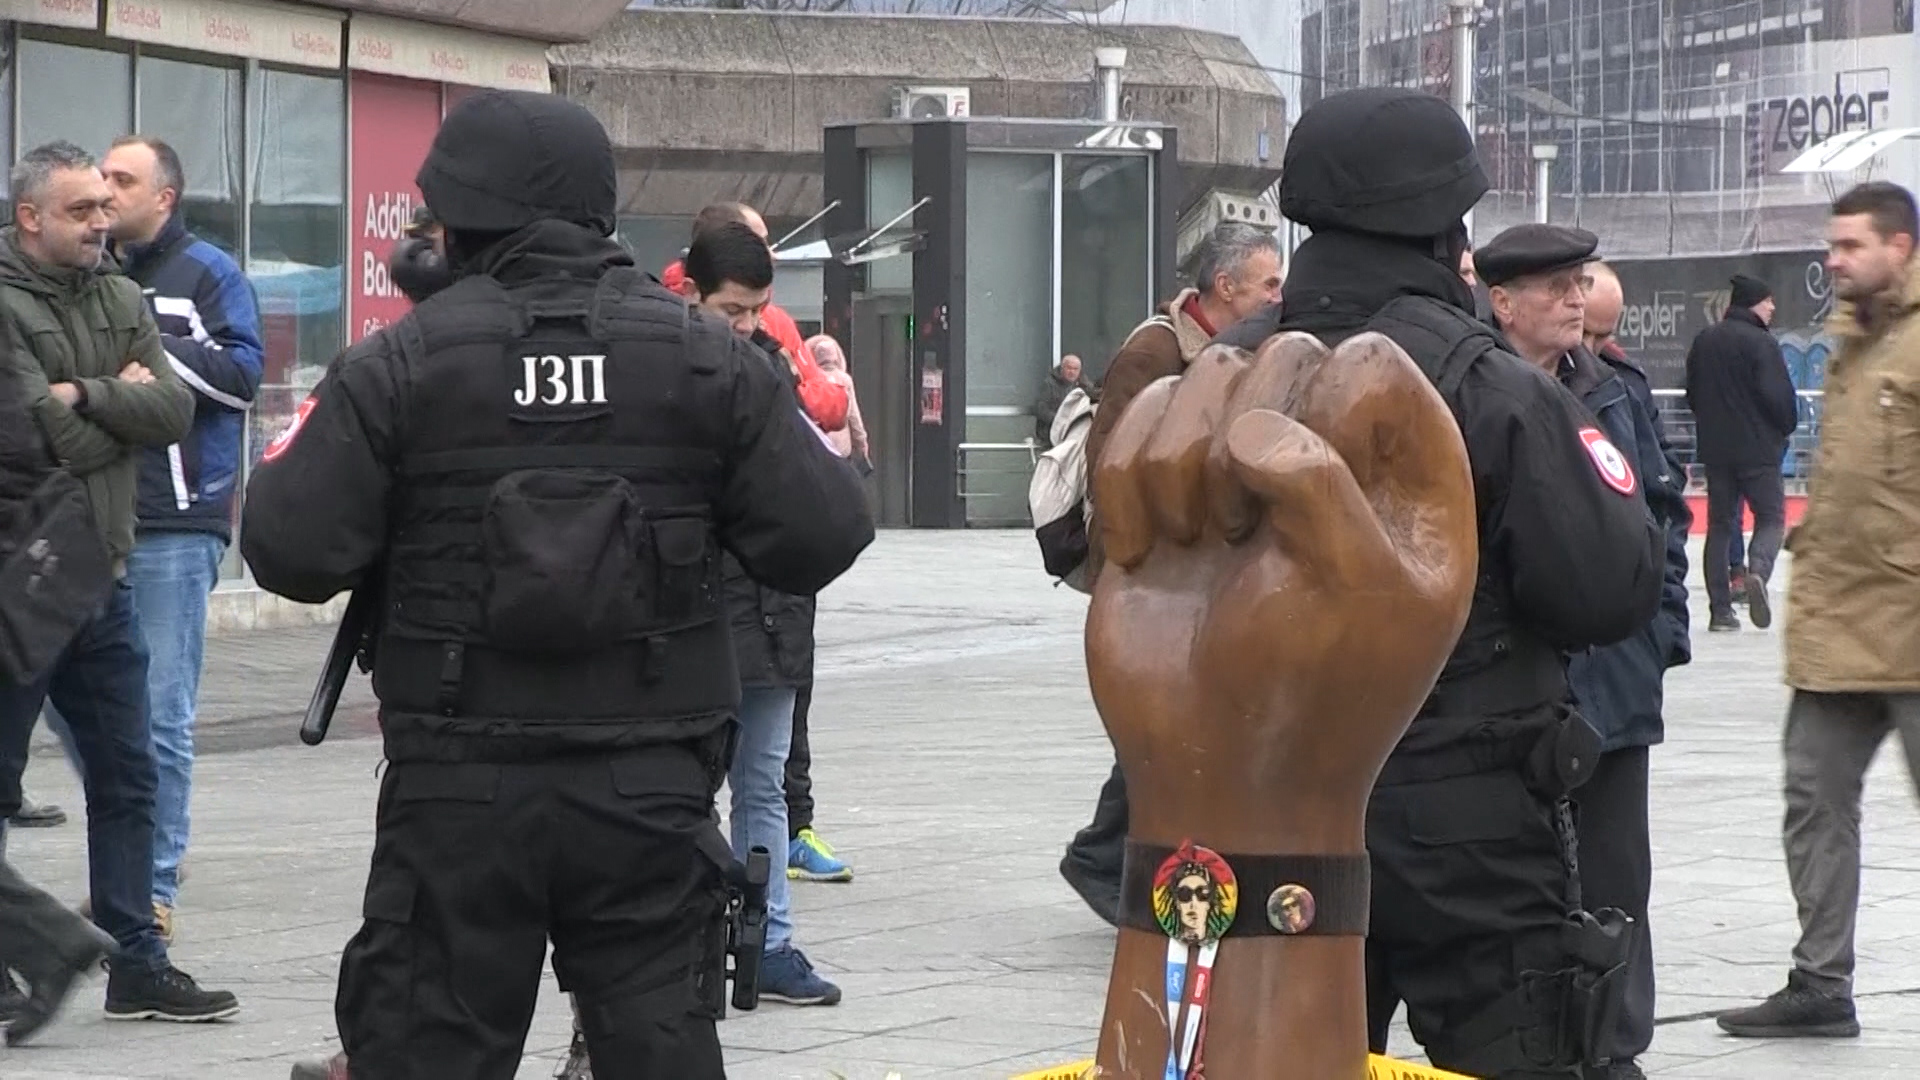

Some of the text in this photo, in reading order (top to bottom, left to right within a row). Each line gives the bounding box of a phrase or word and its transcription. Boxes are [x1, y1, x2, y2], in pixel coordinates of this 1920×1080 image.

[1768, 71, 1889, 152] zepter
[1618, 290, 1686, 350] zepter
[513, 355, 609, 406] ЈЗП
